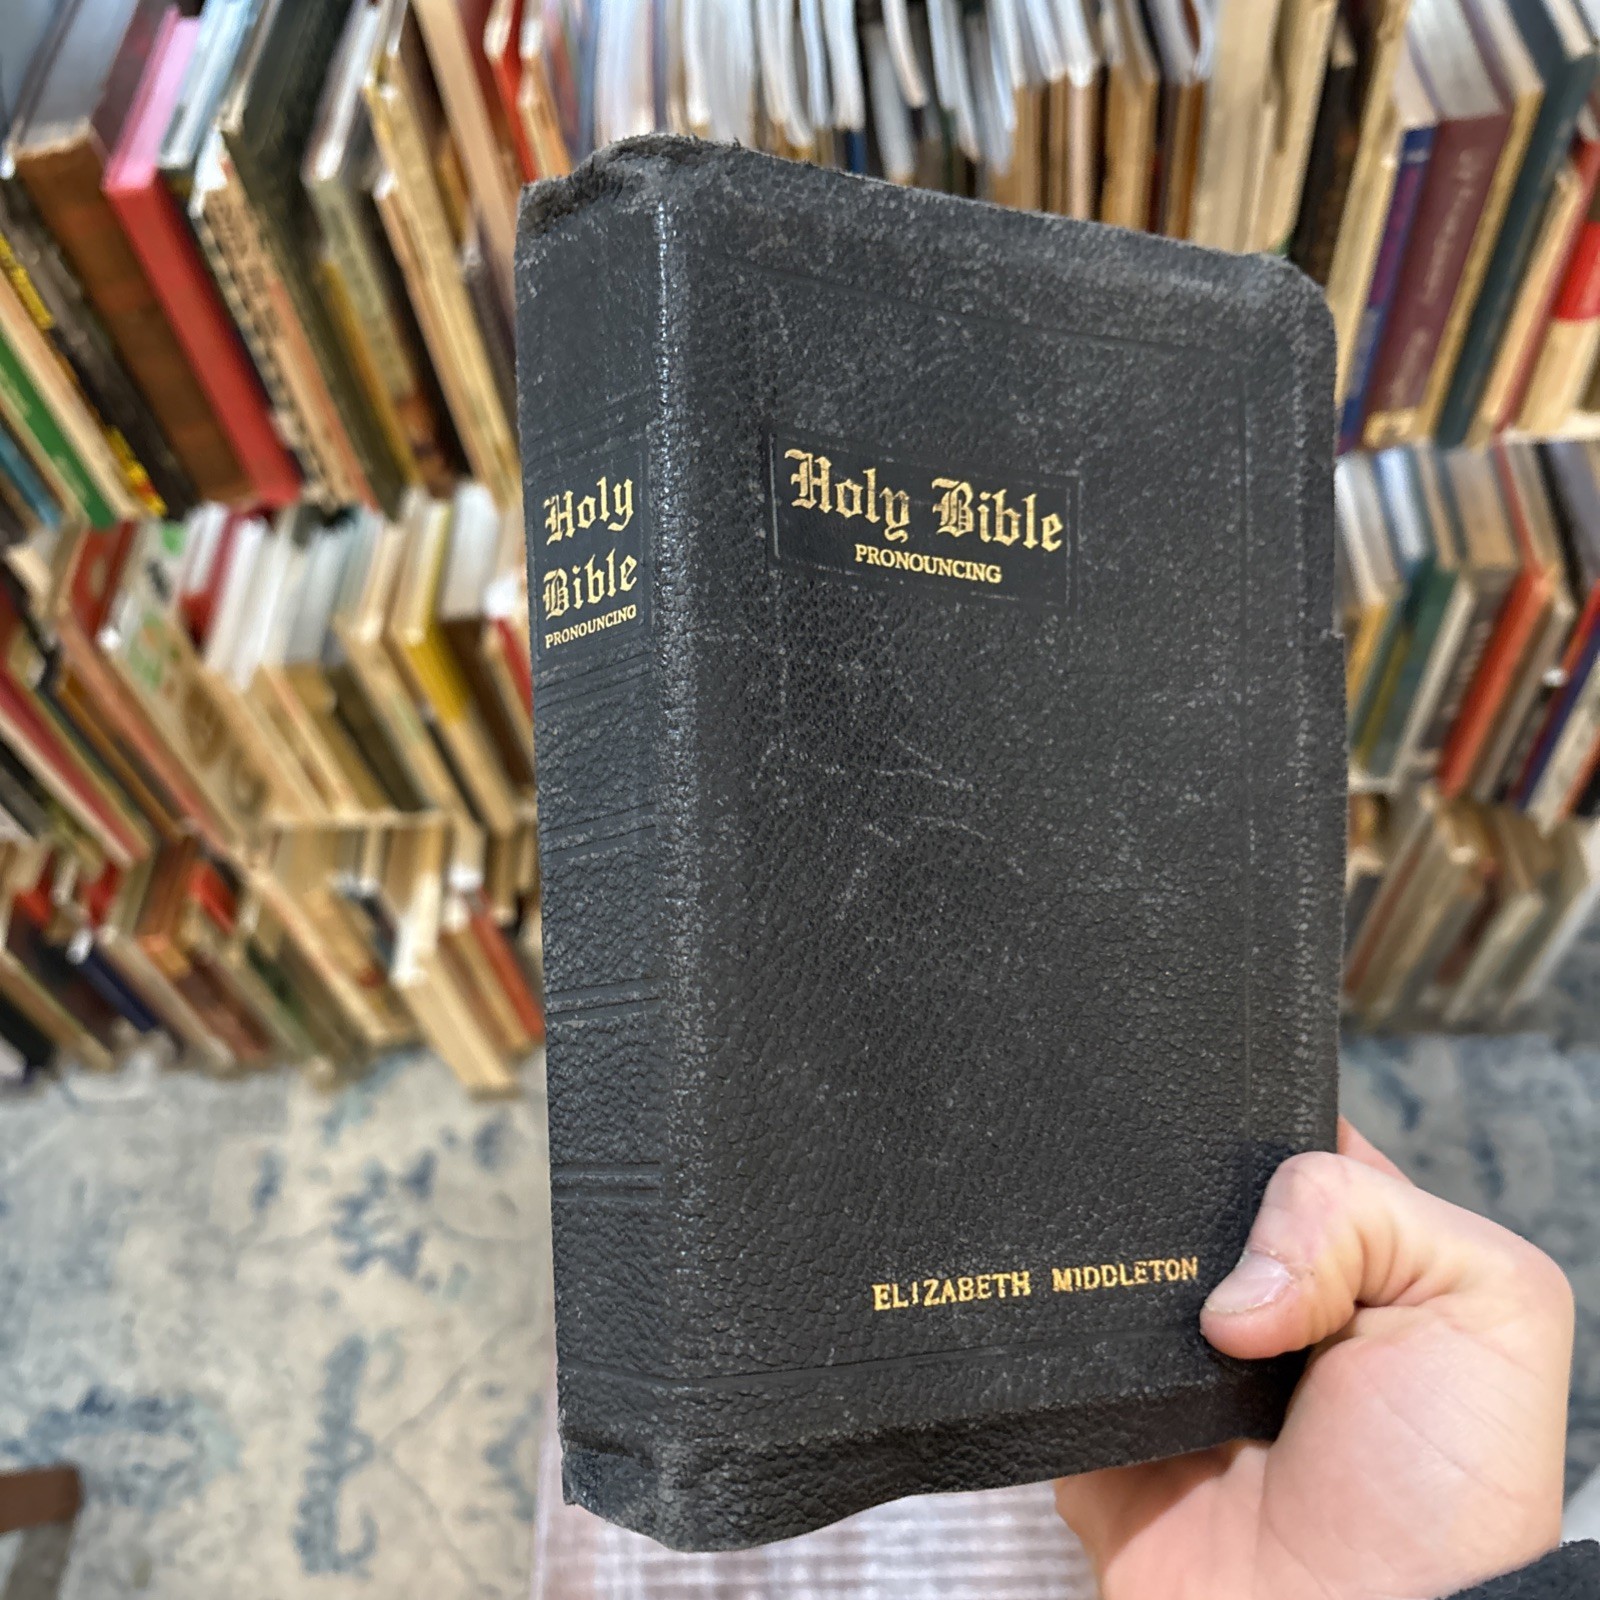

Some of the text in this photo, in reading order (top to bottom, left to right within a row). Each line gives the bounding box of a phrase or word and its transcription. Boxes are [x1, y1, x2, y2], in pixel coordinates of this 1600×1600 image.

[543, 475, 635, 546] Holy
[784, 447, 1064, 552] Holy Bible
[542, 547, 638, 620] Bible
[854, 543, 1003, 585] PRONOUNCING
[545, 603, 637, 649] PRONOUNCING
[872, 1255, 1199, 1312] ELIZABETH MIDDLETON
